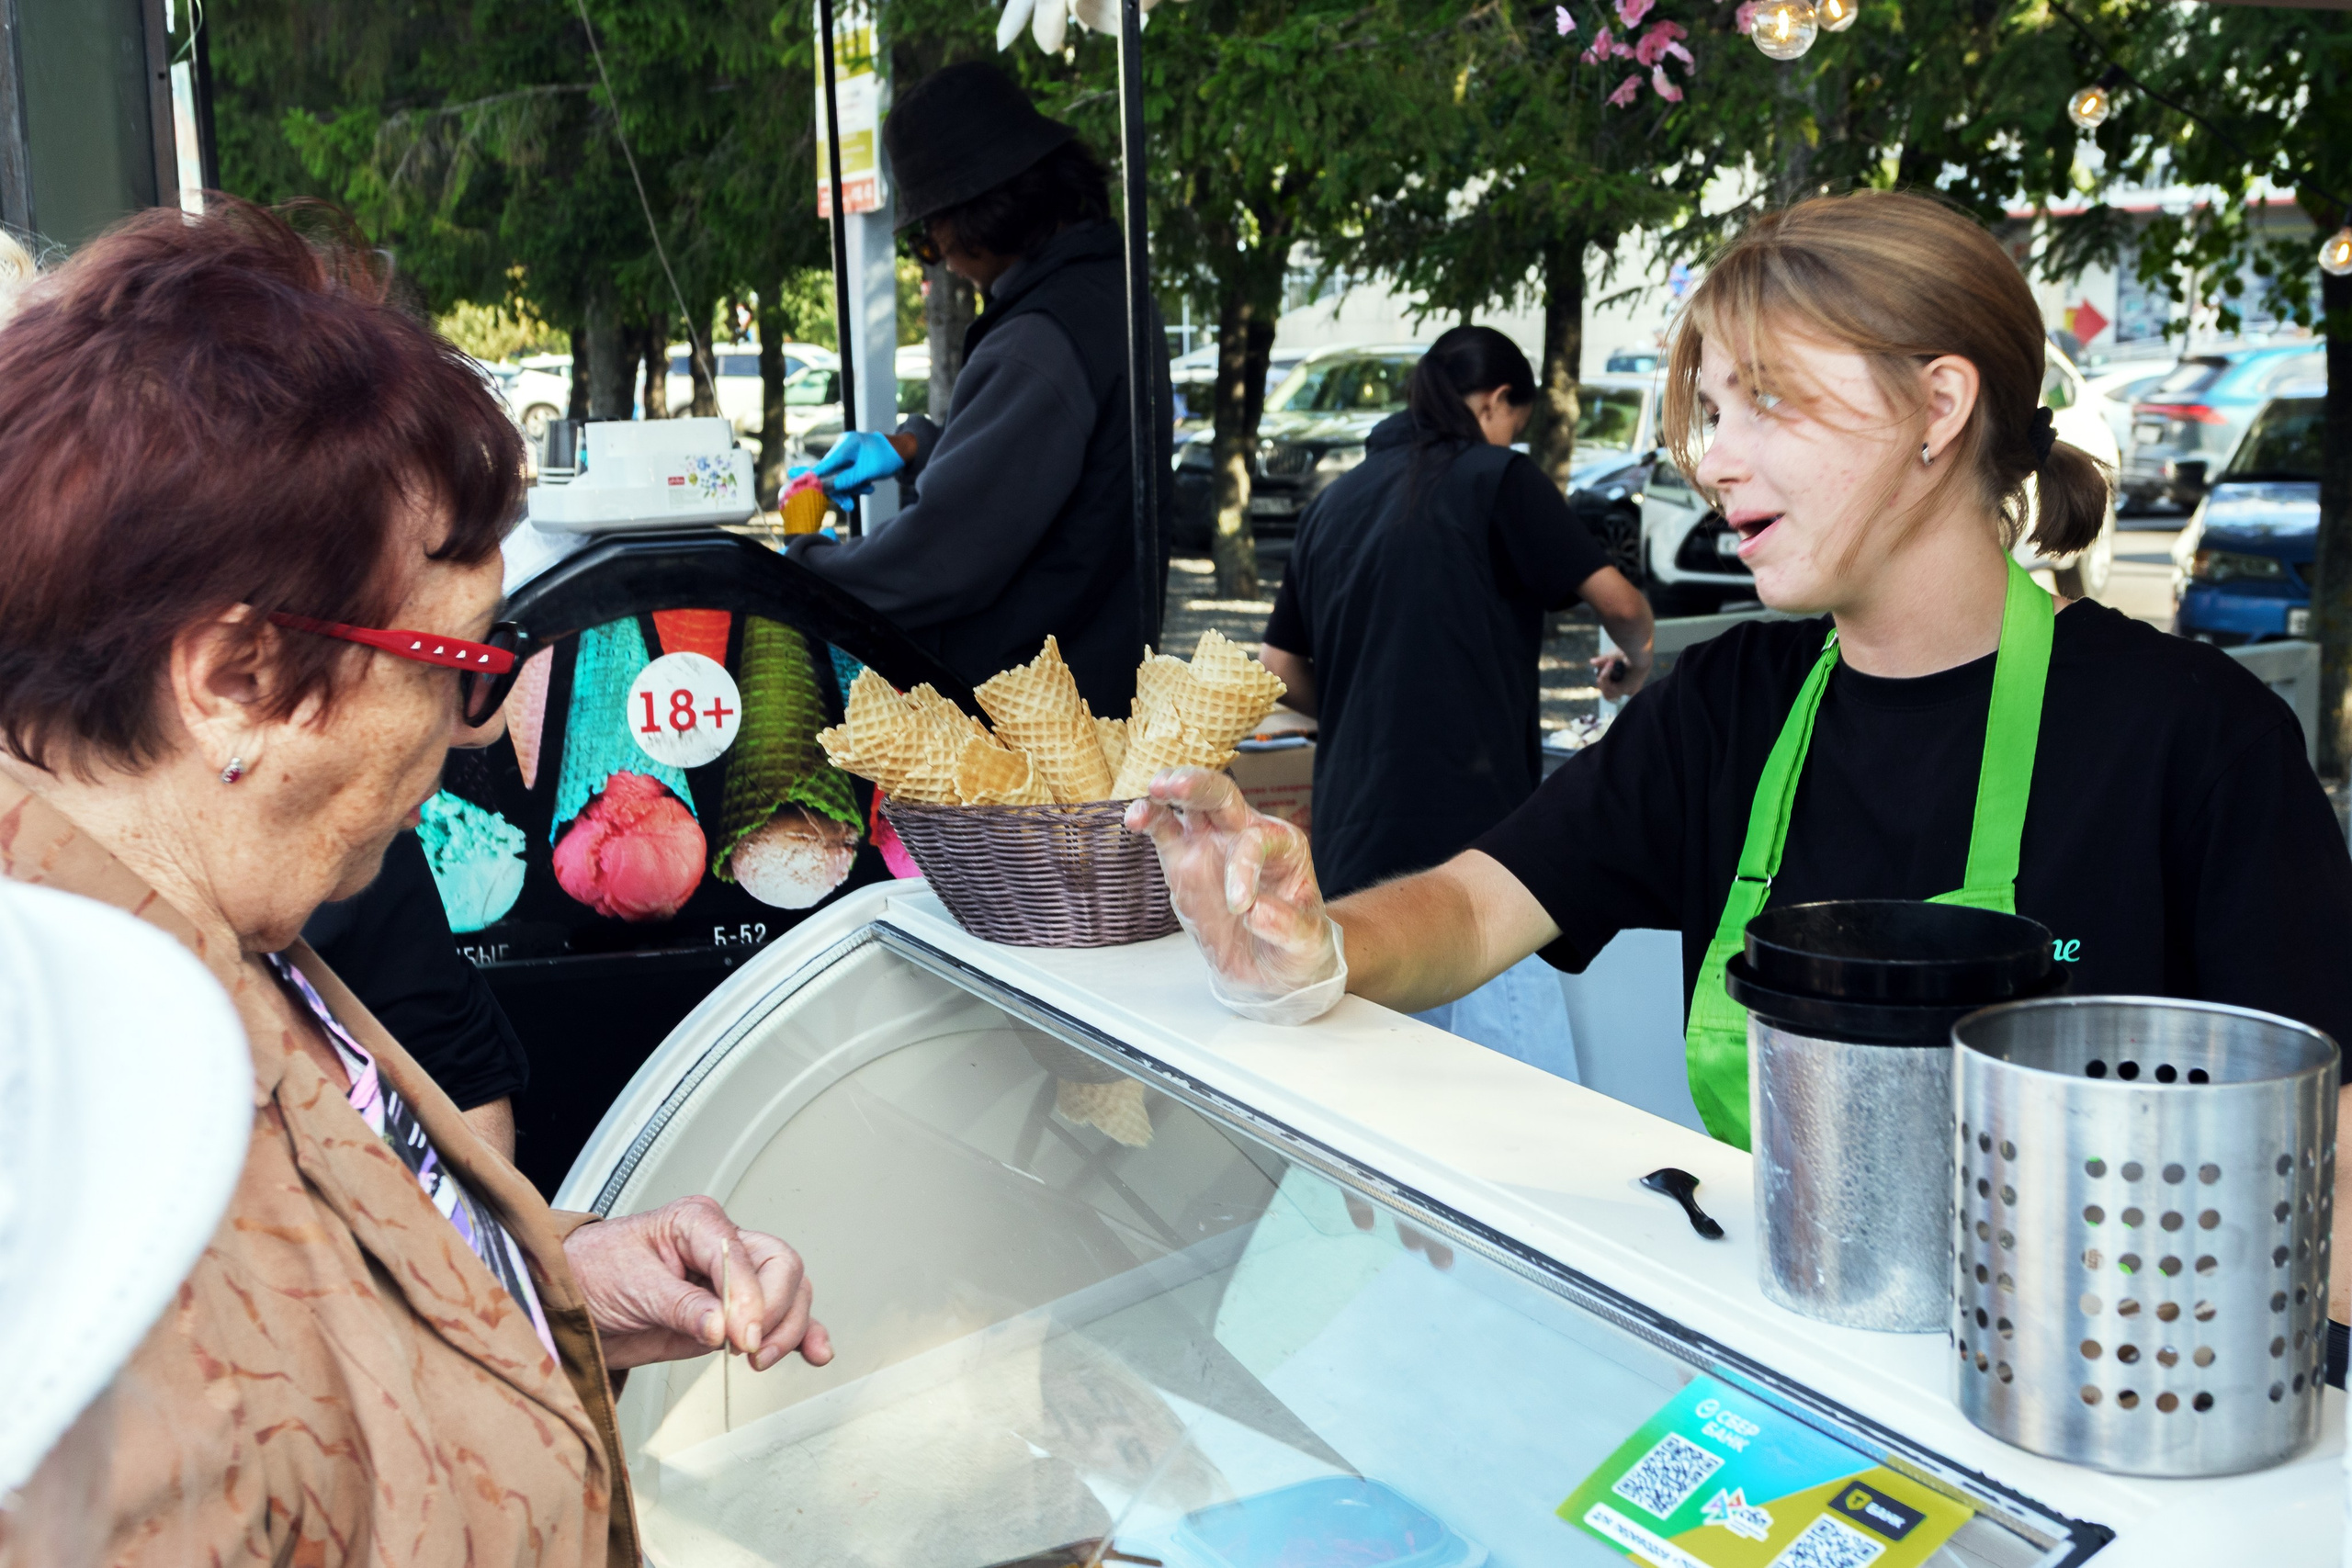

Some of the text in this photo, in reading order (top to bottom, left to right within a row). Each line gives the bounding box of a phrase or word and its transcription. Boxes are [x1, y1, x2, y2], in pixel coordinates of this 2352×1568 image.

[639, 688, 734, 733] 18+
[1701, 1421, 1750, 1453] БАНК
[1715, 1410, 1760, 1437] СБЕР
